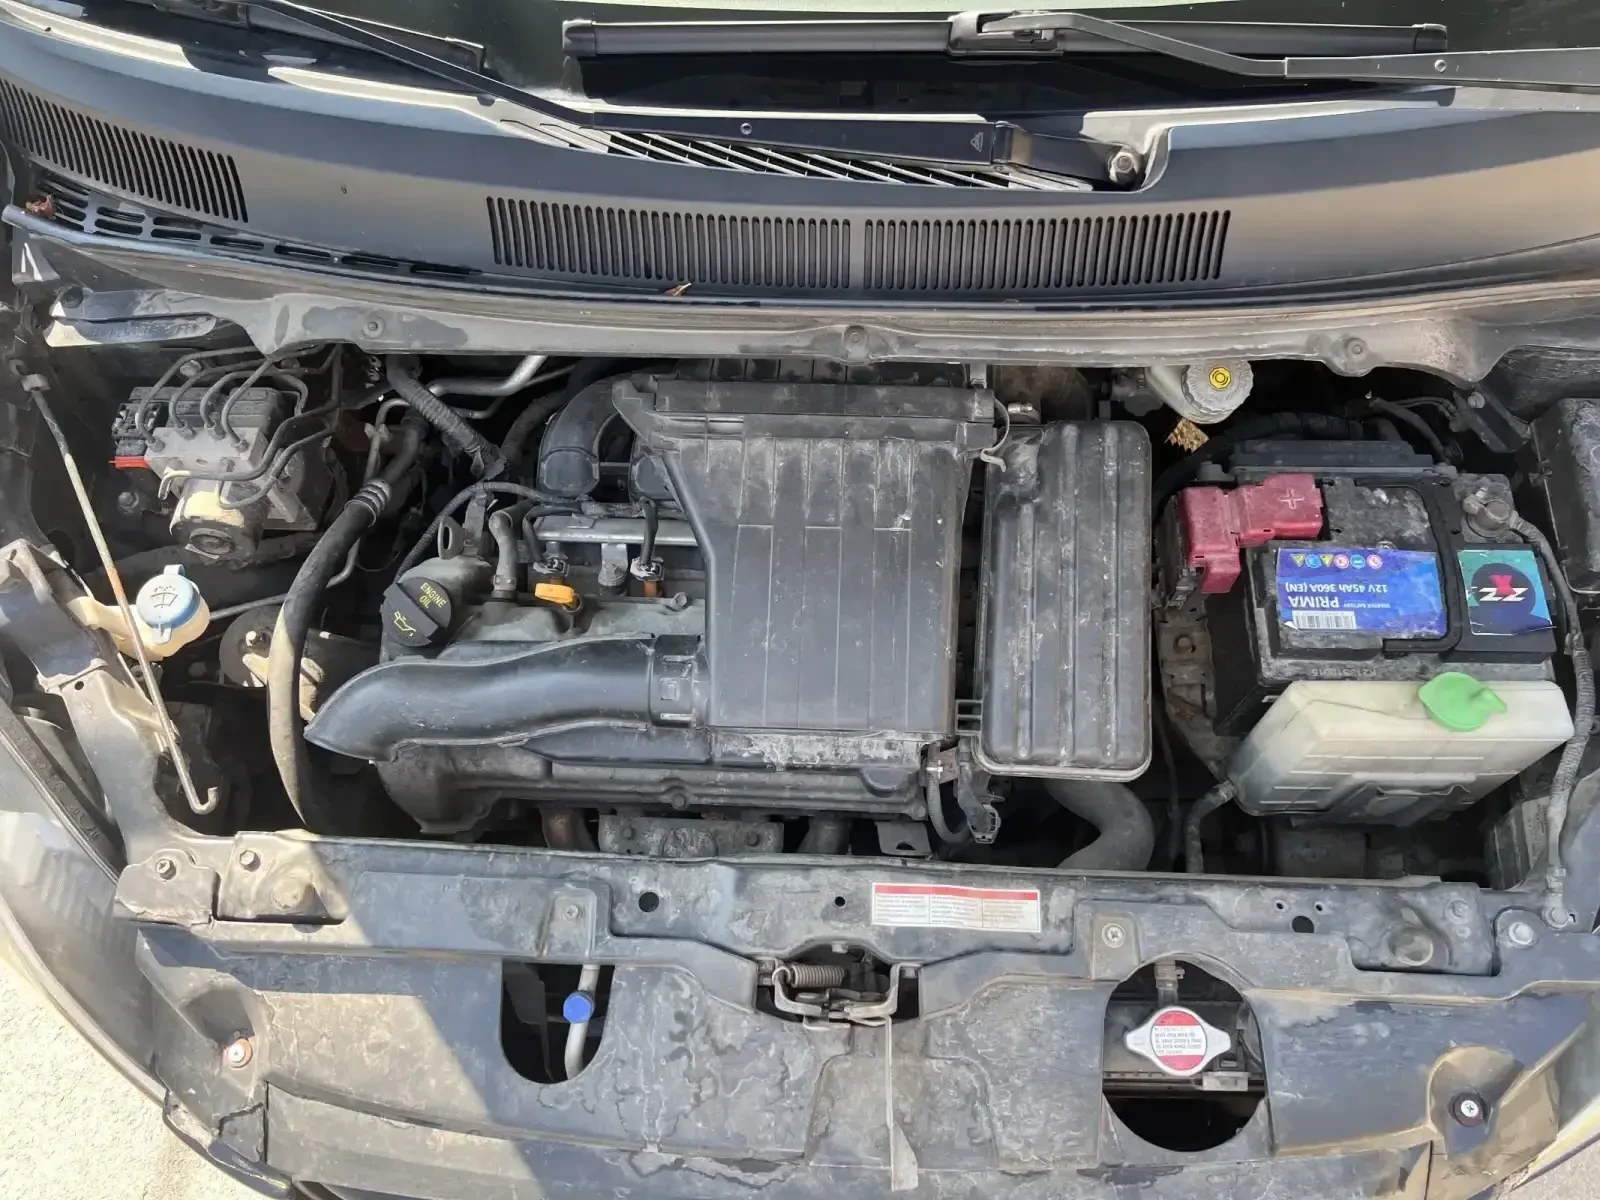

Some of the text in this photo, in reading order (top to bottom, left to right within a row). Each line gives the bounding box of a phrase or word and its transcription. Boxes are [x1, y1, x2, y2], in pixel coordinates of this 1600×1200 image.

[1285, 582, 1388, 593] 12V 45Ah 360A (EN)
[420, 582, 447, 608] ENGINE
[419, 595, 430, 609] OIL
[1288, 596, 1340, 609] PRIMA
